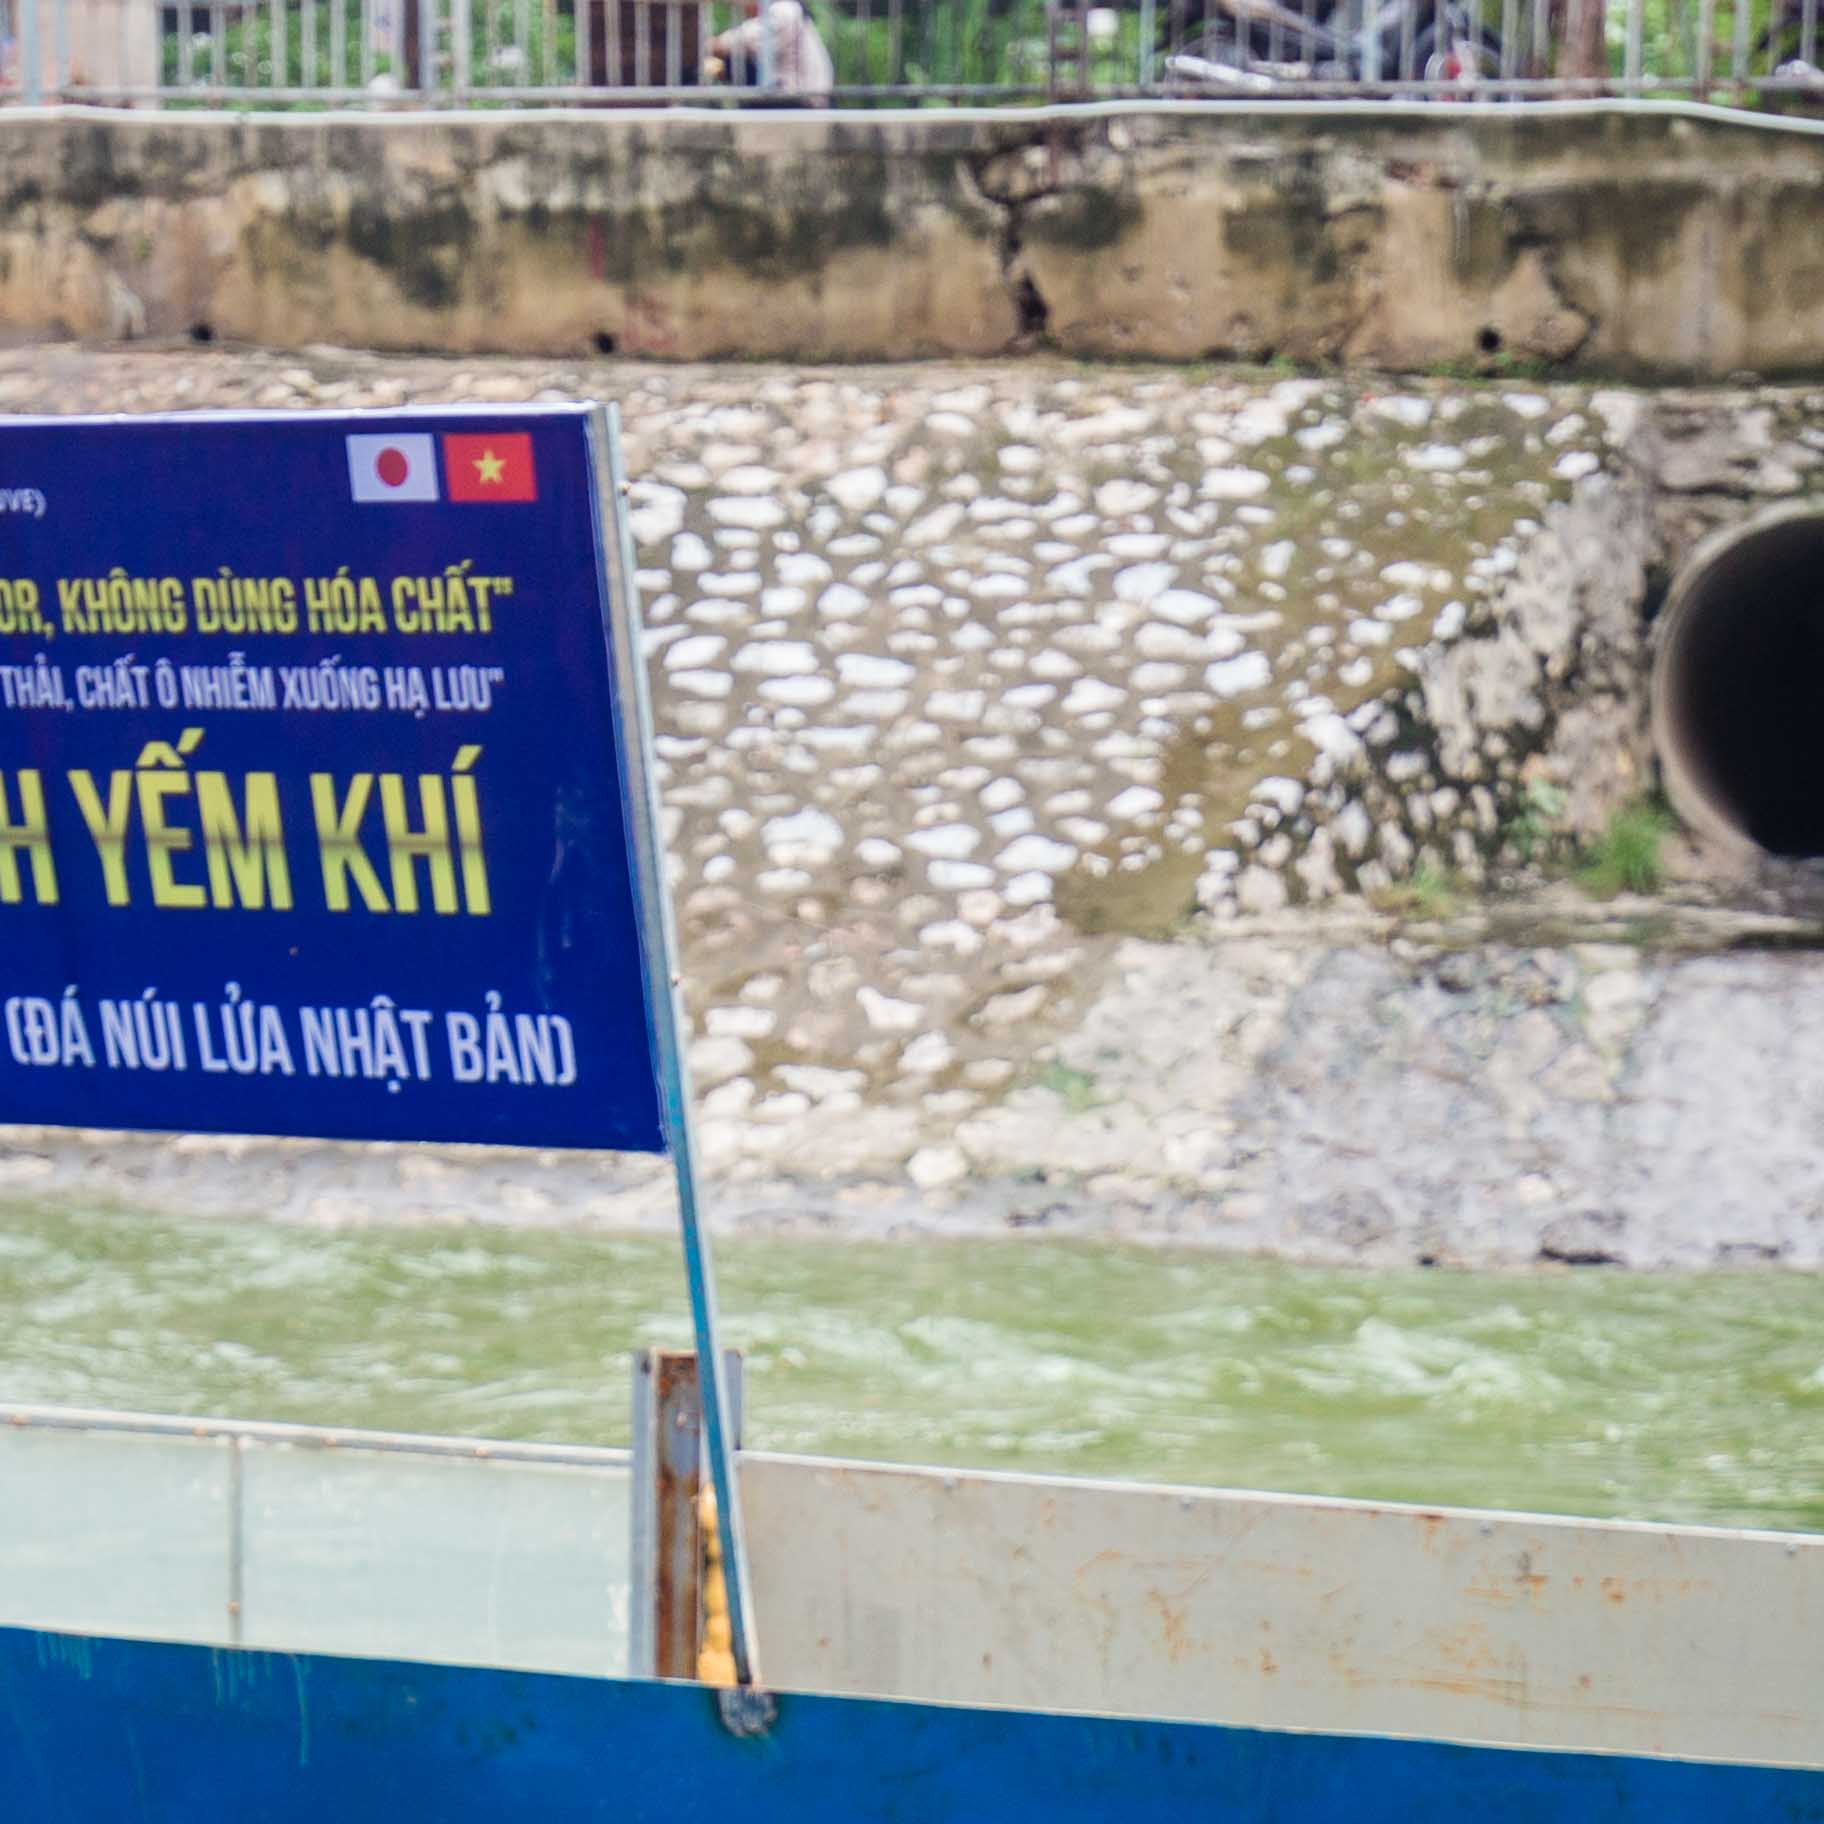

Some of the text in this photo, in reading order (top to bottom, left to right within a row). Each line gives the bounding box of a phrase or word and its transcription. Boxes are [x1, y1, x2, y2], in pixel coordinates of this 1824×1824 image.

[57, 566, 187, 634] KHÔNG
[192, 565, 298, 634] DÙNG
[304, 565, 388, 634] HÓA
[75, 652, 150, 709] CHẤT
[155, 657, 177, 709] Ô
[180, 651, 276, 710] NHIỄM
[278, 654, 381, 710] XUỐNG
[384, 666, 431, 719] HẠ
[68, 728, 293, 910] YẾM
[309, 744, 491, 915] KHÍ
[8, 985, 95, 1068] (ĐÁ
[101, 987, 186, 1071] NÚI
[194, 982, 294, 1076] LỬA
[302, 995, 432, 1092] NHẬT
[448, 990, 576, 1085] BẢN)
